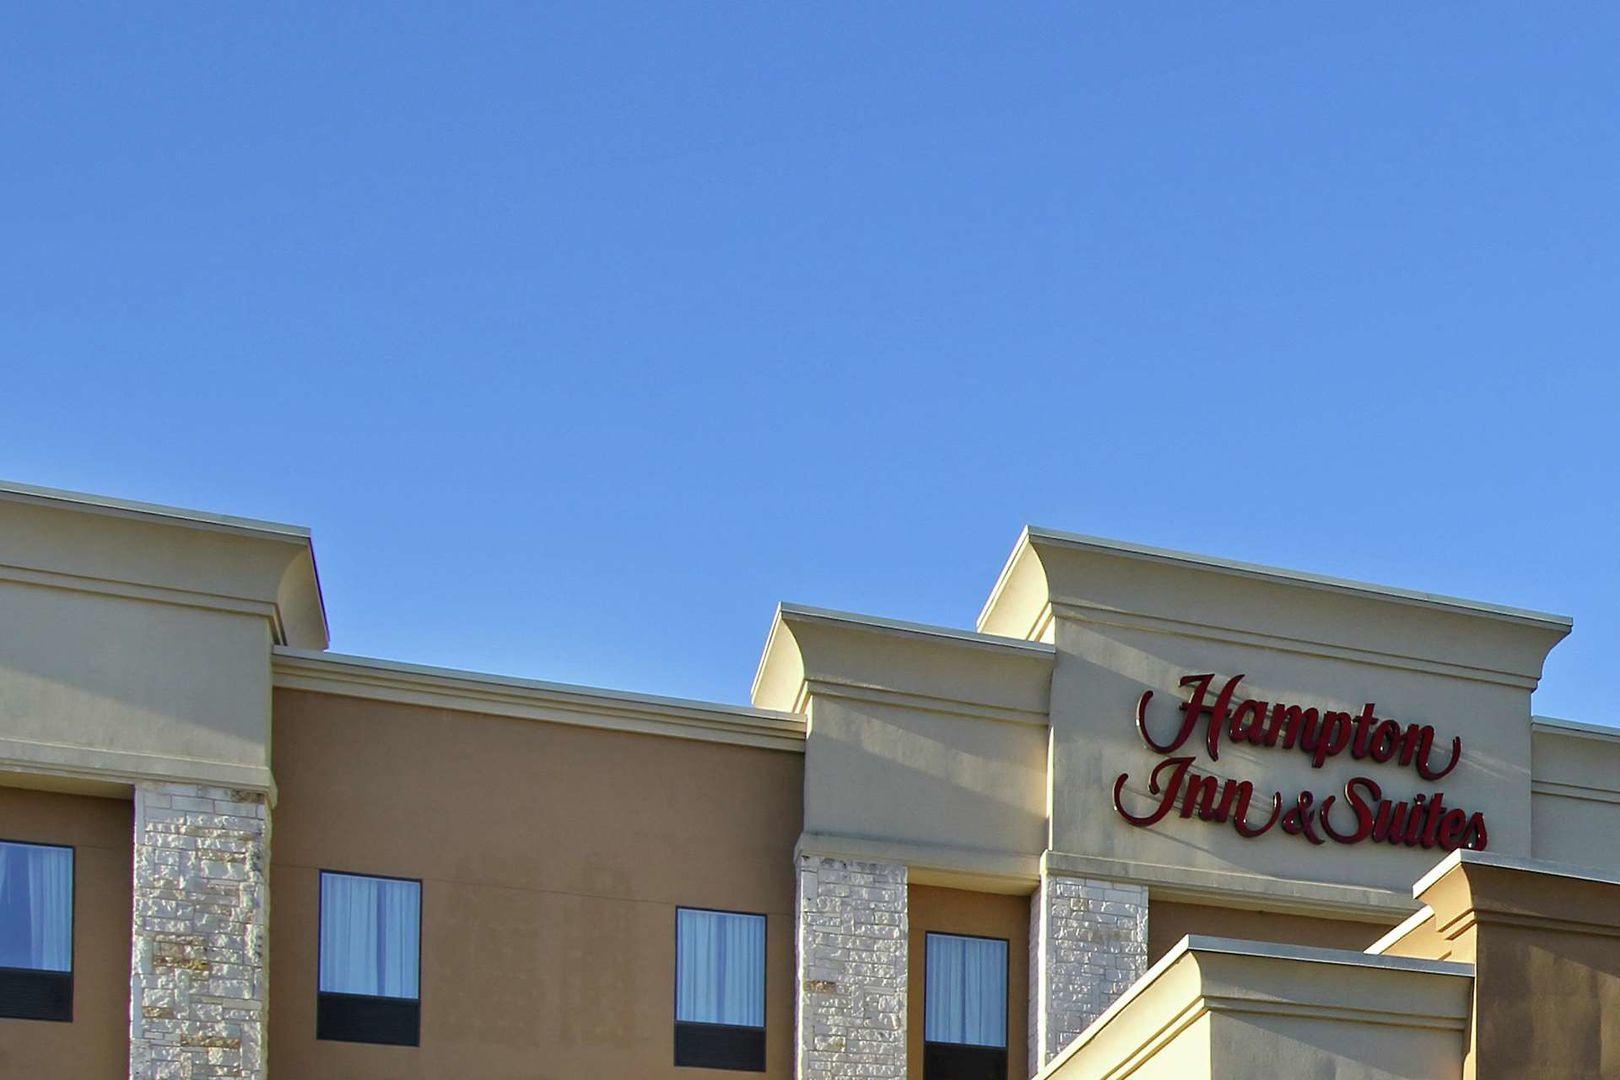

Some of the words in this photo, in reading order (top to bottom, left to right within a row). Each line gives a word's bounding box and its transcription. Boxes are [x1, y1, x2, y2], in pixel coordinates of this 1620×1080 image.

[1136, 674, 1462, 781] Hampton
[1113, 757, 1282, 838] Inn
[1281, 790, 1325, 845] &
[1320, 777, 1488, 852] Suites
